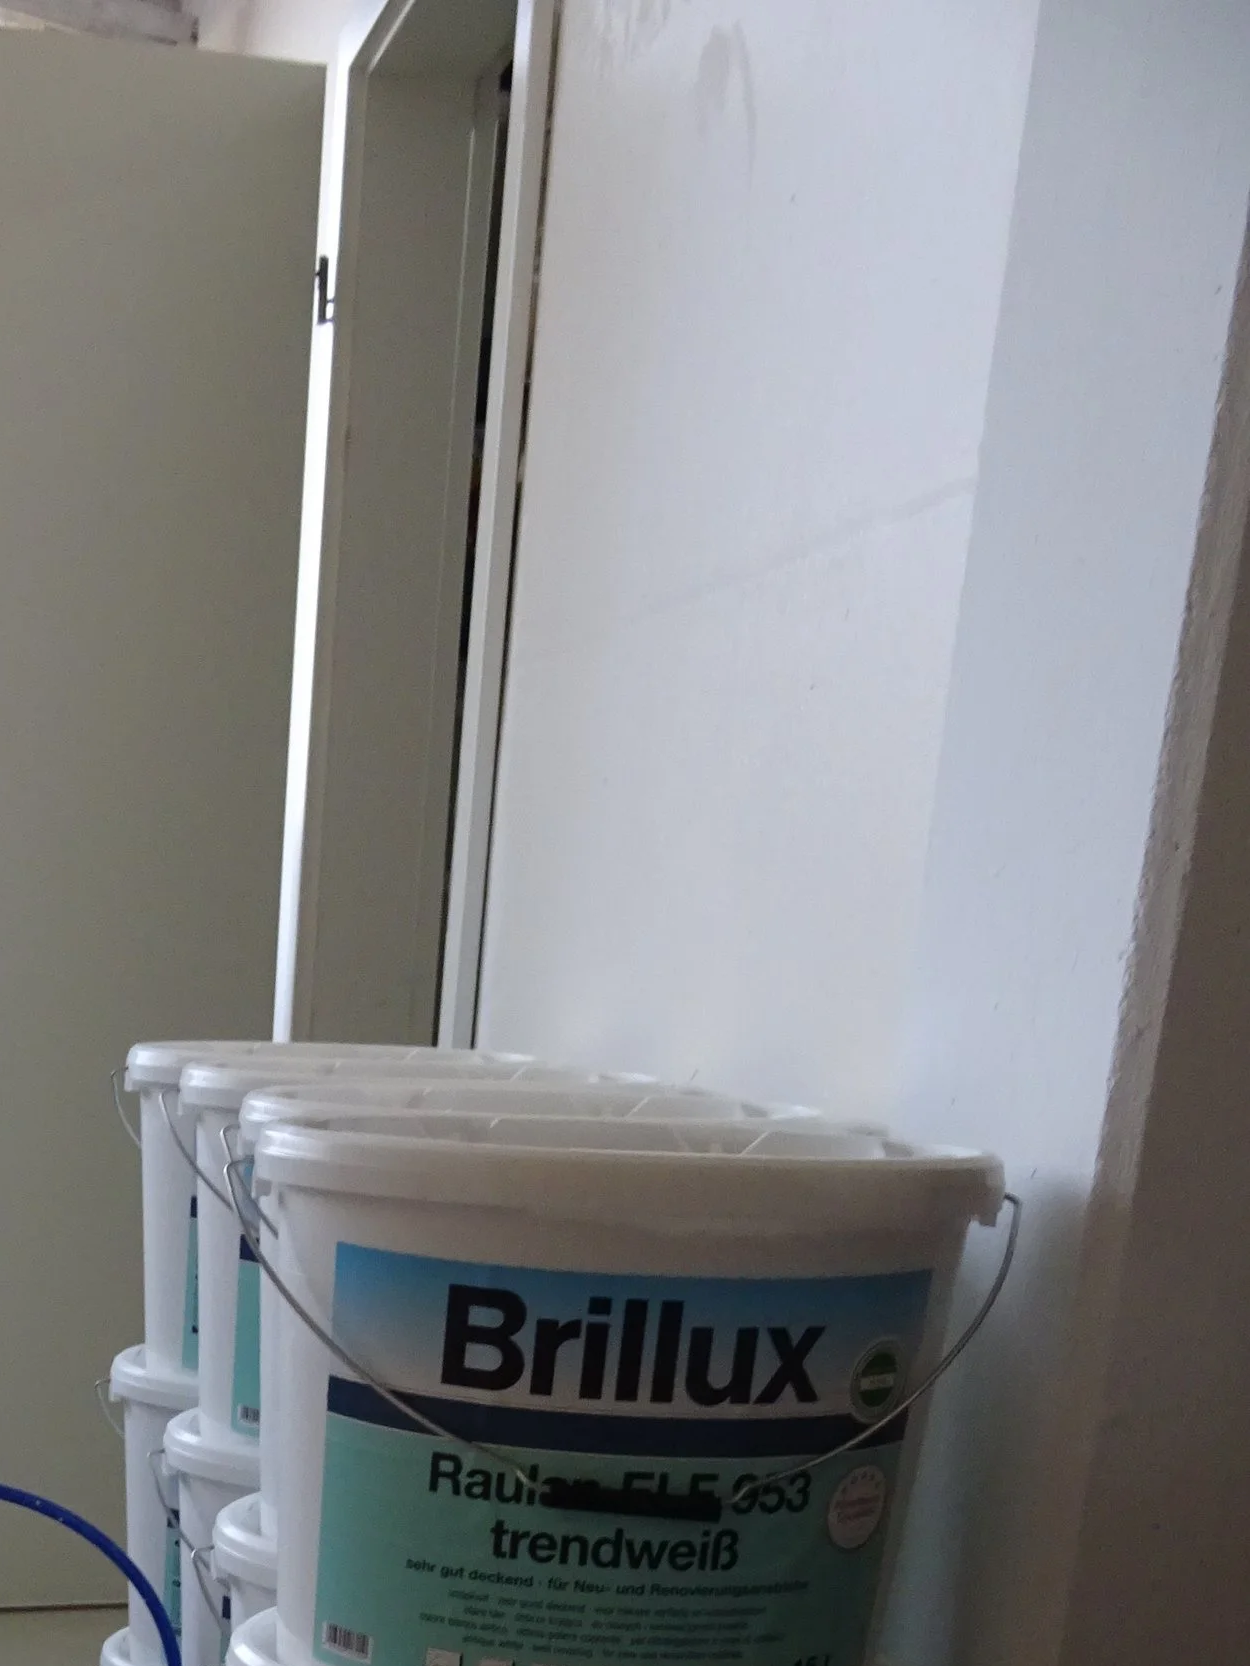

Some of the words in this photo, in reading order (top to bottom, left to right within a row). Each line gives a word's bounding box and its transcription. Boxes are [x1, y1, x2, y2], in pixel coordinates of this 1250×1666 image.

[441, 1284, 825, 1405] Brillux
[731, 1470, 811, 1515] 953
[491, 1519, 739, 1571] trendweiß
[406, 1558, 437, 1573] sehr
[440, 1566, 464, 1579] gut
[468, 1569, 534, 1588] deckend
[548, 1576, 569, 1591] für
[616, 1582, 645, 1596] und
